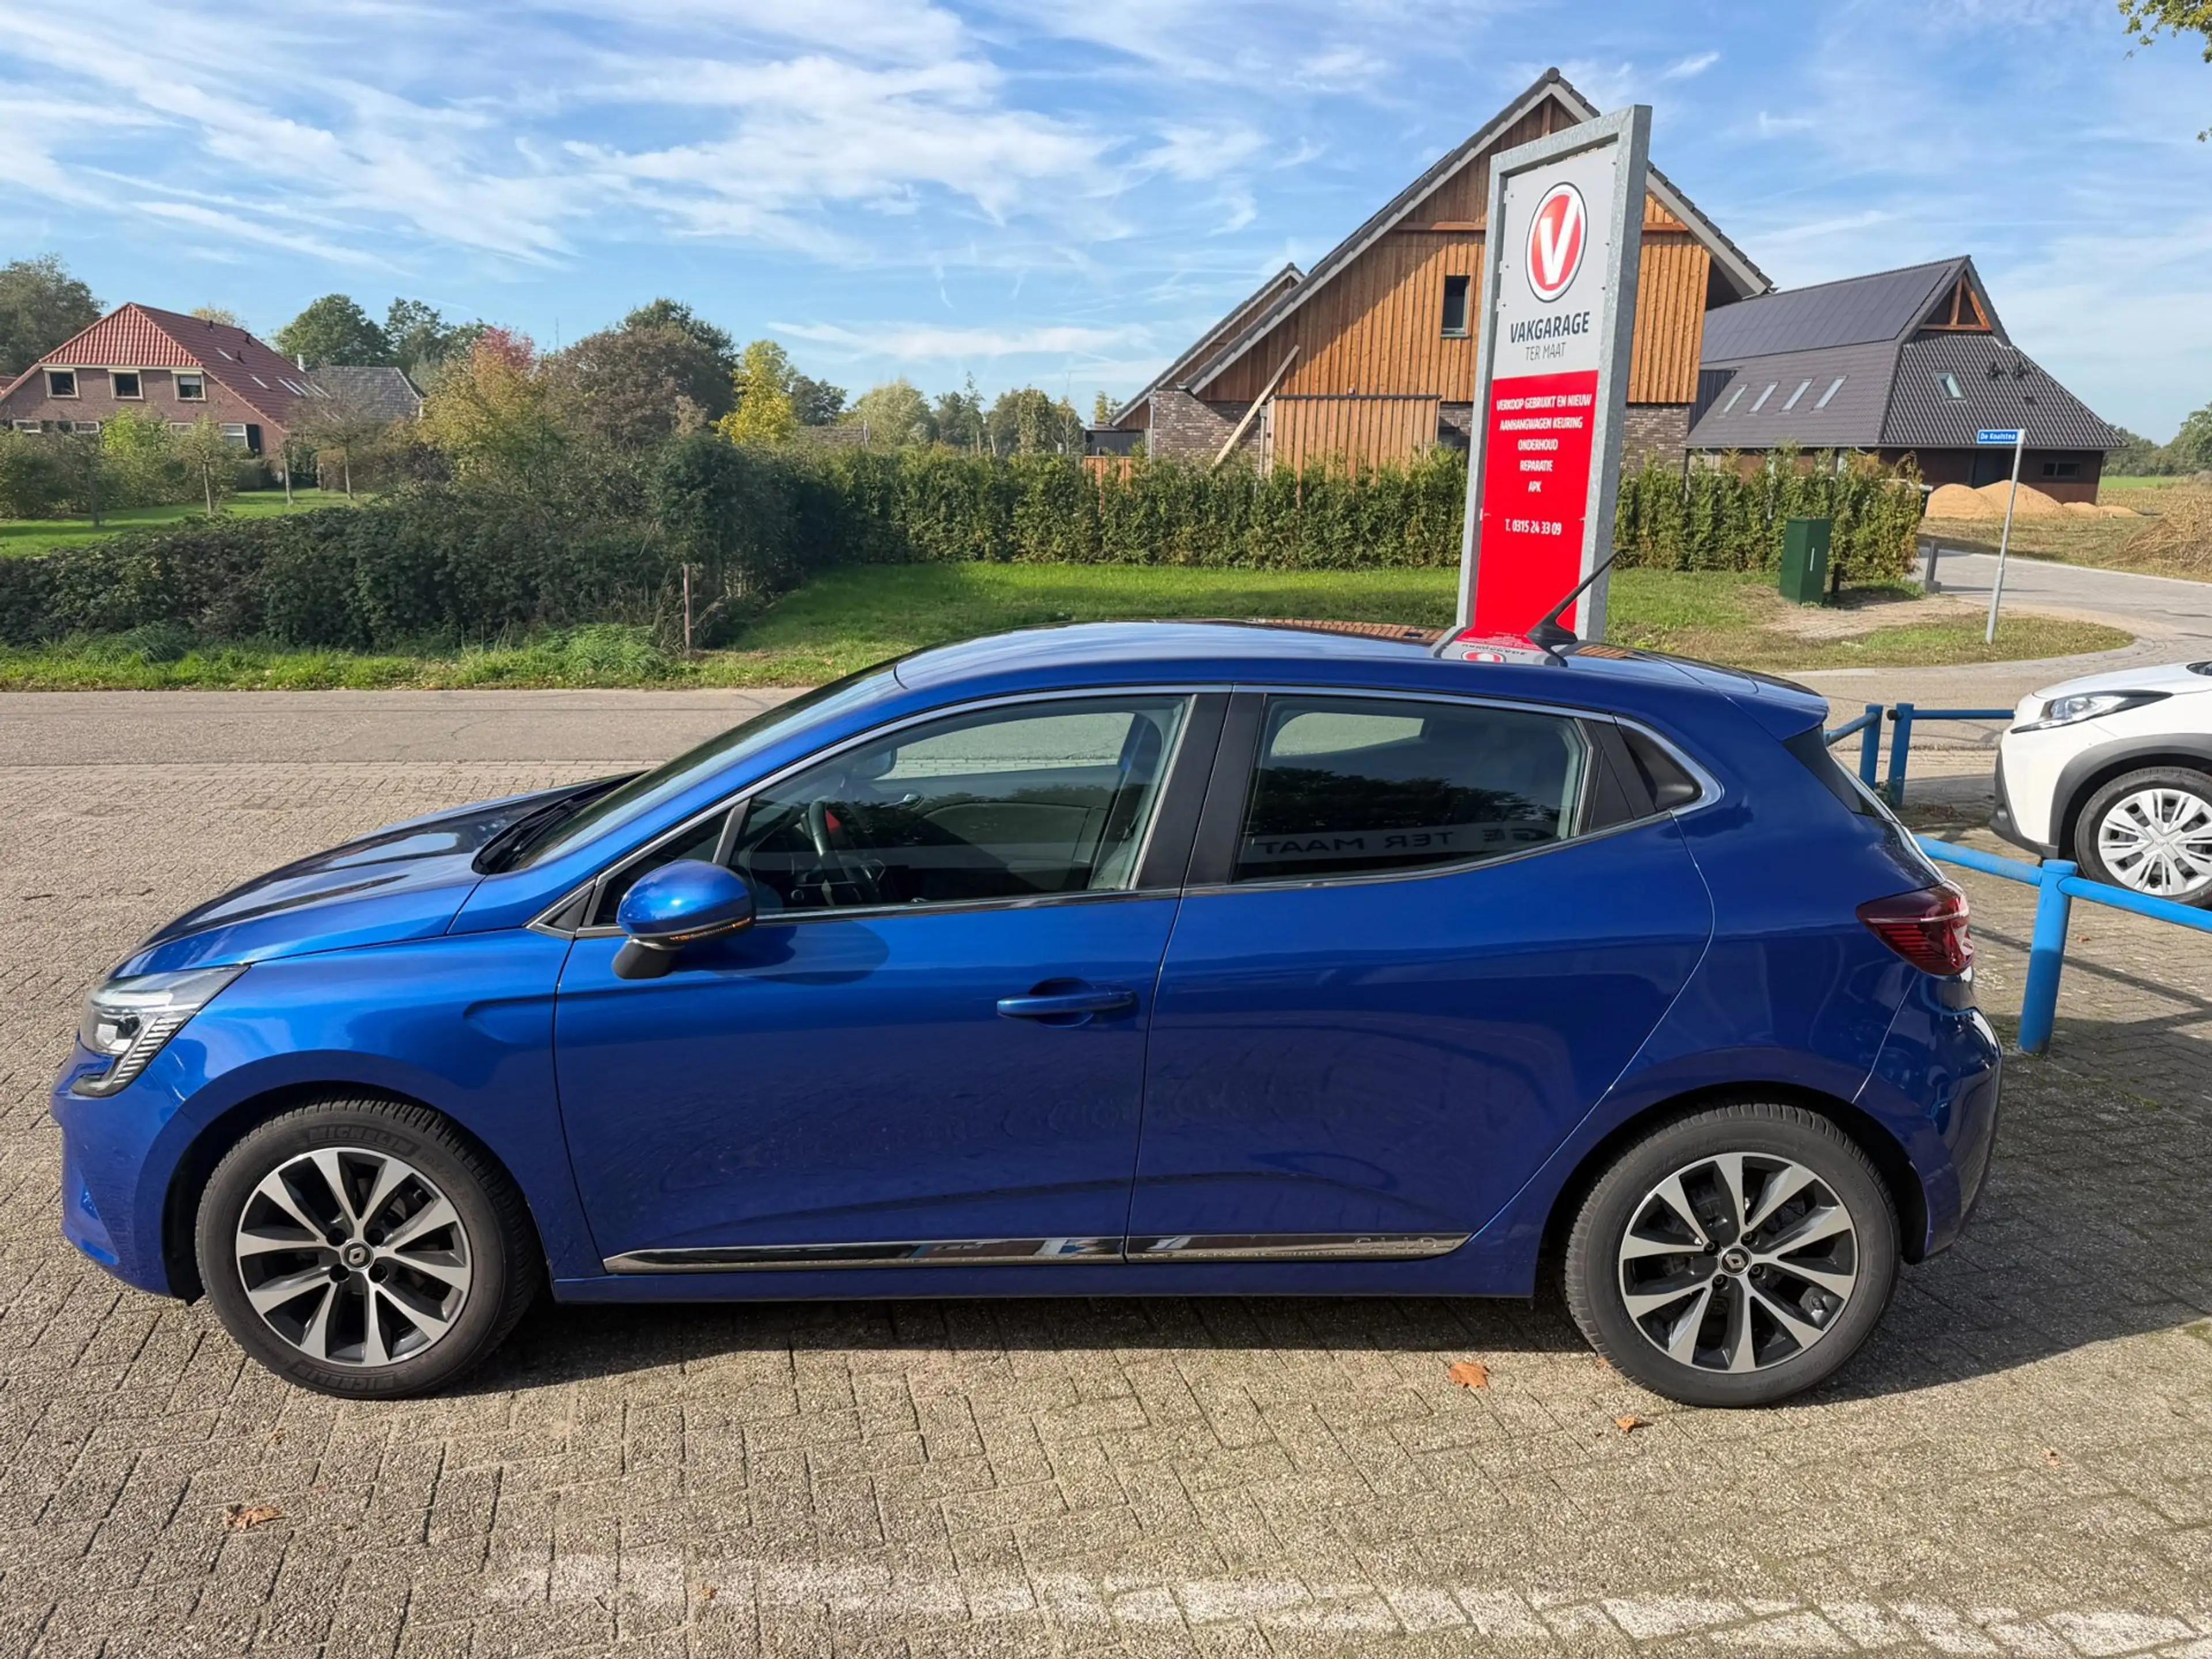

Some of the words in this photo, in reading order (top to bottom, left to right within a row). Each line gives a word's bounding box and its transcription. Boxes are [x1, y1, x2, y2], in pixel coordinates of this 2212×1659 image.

[1510, 311, 1590, 343] VAKGARAGE
[1525, 346, 1541, 361] TER
[1542, 342, 1566, 359] MAAT
[1497, 398, 1524, 411] VERKOOP
[1524, 396, 1556, 409] GEBRUIKT
[1556, 395, 1566, 407] EN
[1567, 393, 1592, 406] NIEUW
[1499, 417, 1552, 431] AANHANGWAGEN
[1552, 416, 1584, 429] KEURING
[1517, 439, 1559, 451] ONDERHOUD
[1519, 460, 1554, 472] REPARATIE
[1528, 480, 1542, 493] APK
[1512, 519, 1530, 533] 0315
[1530, 520, 1540, 533] 24
[1541, 521, 1551, 535] 33
[1551, 522, 1562, 536] 09
[309, 1125, 419, 1156] MICHELIN
